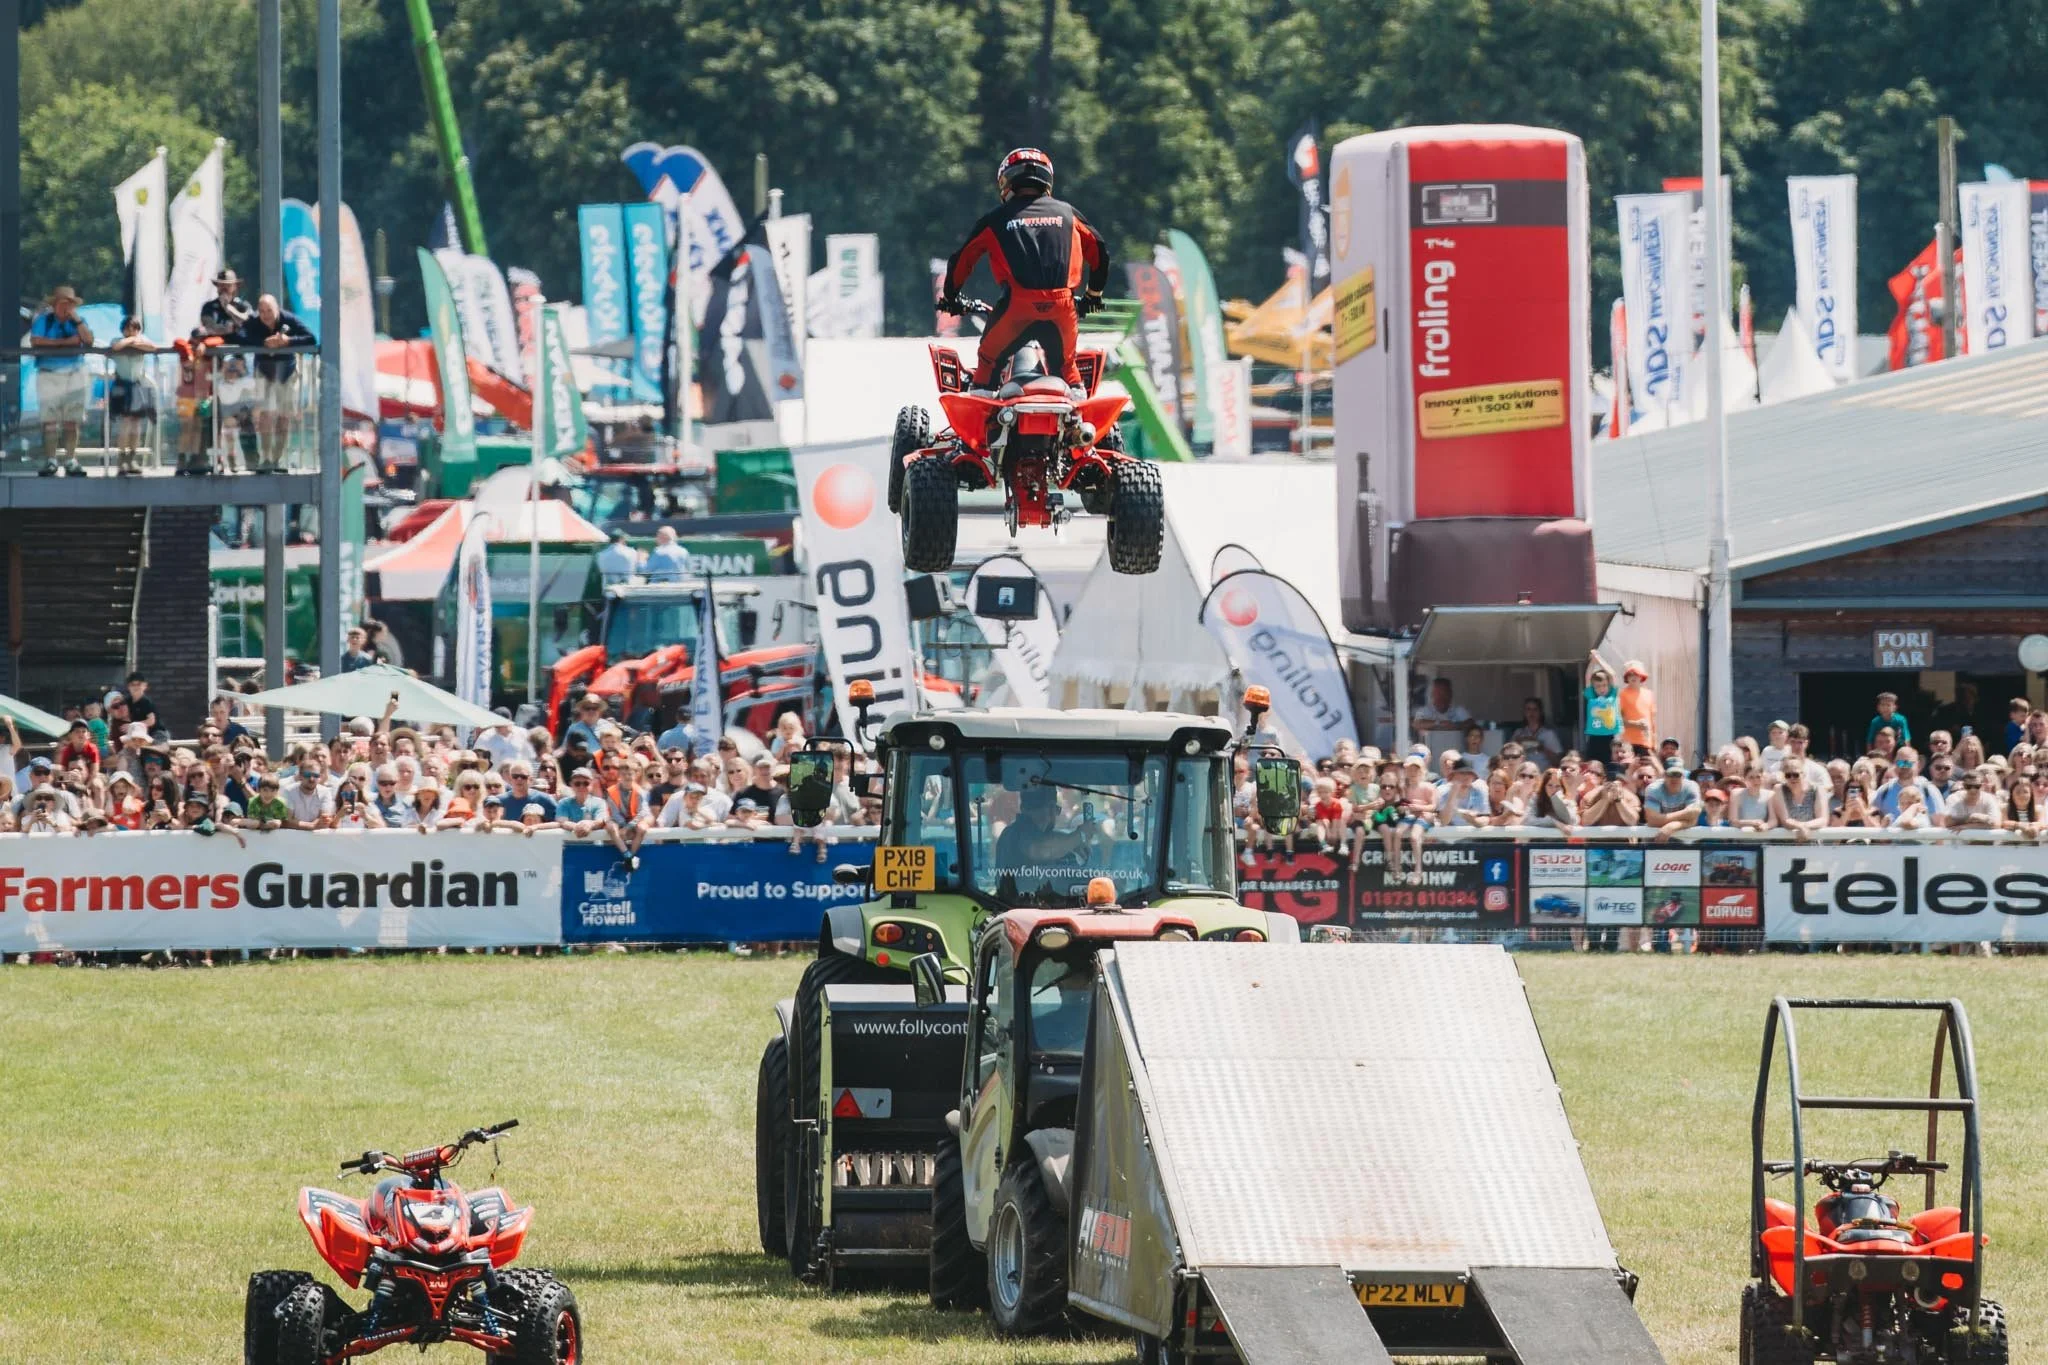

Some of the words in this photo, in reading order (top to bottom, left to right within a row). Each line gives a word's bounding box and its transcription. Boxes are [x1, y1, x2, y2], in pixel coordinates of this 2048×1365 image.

[1425, 393, 1494, 409] Innovative
[1499, 388, 1559, 401] solutions
[690, 555, 752, 576] ENAN
[1882, 651, 1925, 666] BAR
[883, 849, 926, 866] PX18
[1361, 850, 1479, 865] CRKOWELL
[1532, 854, 1582, 865] ISUZU
[988, 865, 1143, 879] www.follycontractors.co.uk
[1654, 862, 1692, 872] LOGIC
[886, 870, 923, 888] CHF
[1779, 856, 2048, 916] teles
[697, 881, 751, 899] Proud
[764, 882, 786, 899] to
[578, 901, 632, 914] Castell
[1597, 902, 1636, 911] M-TEC
[1706, 906, 1753, 918] CORVUS
[583, 912, 636, 926] Howell
[1415, 1284, 1456, 1302] MLV
